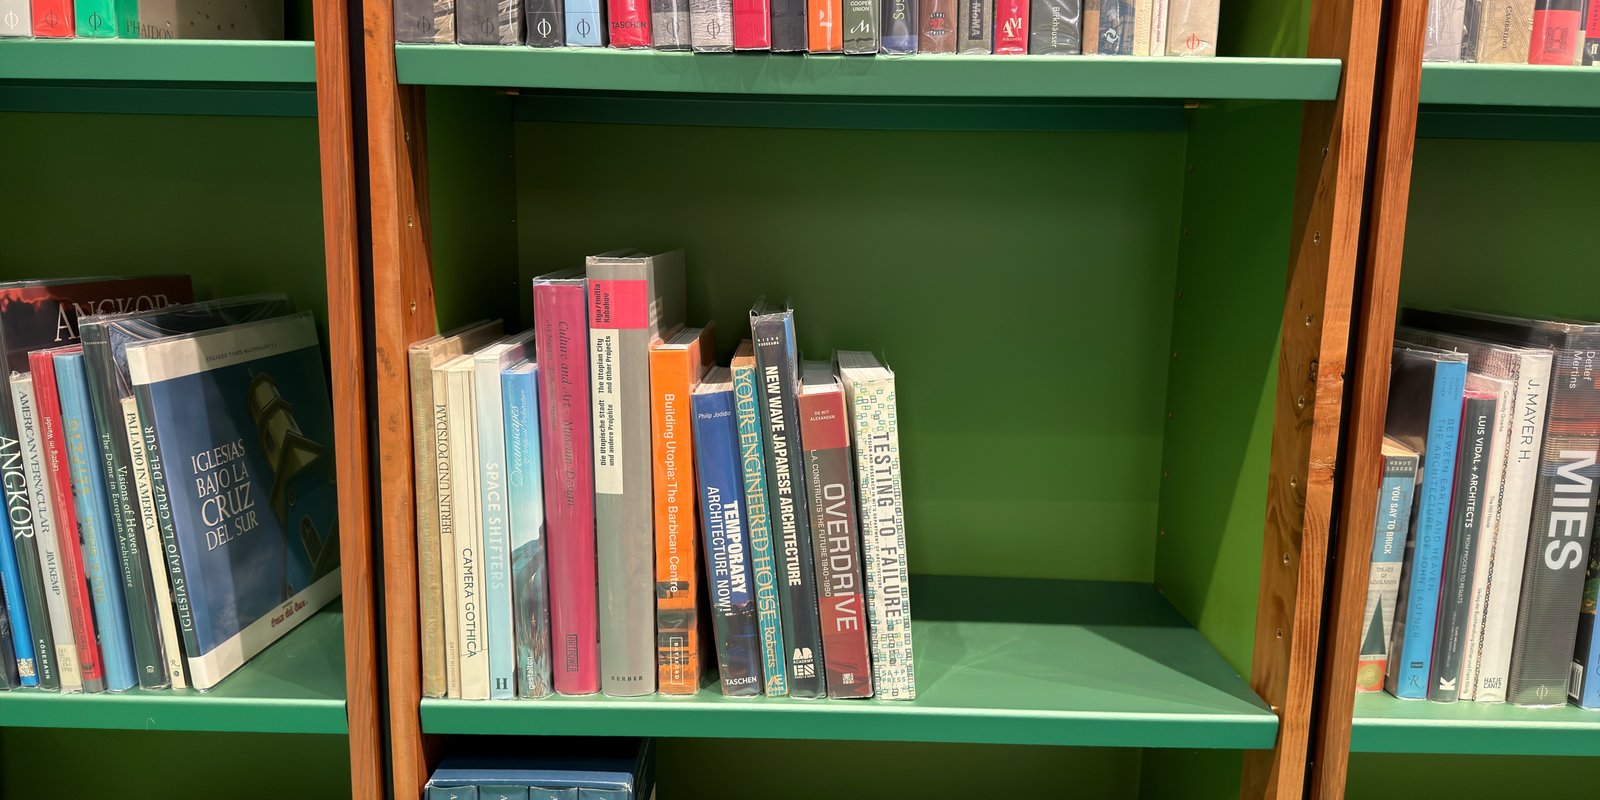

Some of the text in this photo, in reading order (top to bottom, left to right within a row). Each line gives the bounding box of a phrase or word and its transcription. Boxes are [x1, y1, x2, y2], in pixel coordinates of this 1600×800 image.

[126, 19, 174, 39] PHAIDON
[611, 21, 647, 29] TASCHEN
[1051, 6, 1061, 48] Birkhäuser
[1501, 5, 1513, 50] CAMBRIDGE
[559, 321, 571, 362] Culture
[596, 338, 604, 352] City
[560, 362, 573, 386] and
[597, 354, 605, 380] Utopian
[605, 361, 613, 381] Other
[1568, 350, 1584, 390] Mertins
[1583, 350, 1596, 381] Detlef
[598, 399, 606, 418] Stadt
[698, 410, 732, 420] Philip Jodidio
[734, 368, 756, 429] YOUR
[1519, 393, 1539, 445] MAYER
[44, 416, 54, 440] Wandel
[563, 418, 574, 466] Museum
[599, 420, 607, 454] Utopische
[1478, 415, 1487, 435] LUIS
[19, 391, 50, 533] AMERICAN VERNACULAR
[50, 449, 59, 472] Leipzig
[190, 438, 246, 475] IGLESIAS
[510, 405, 524, 488] Dreamscapes
[1473, 436, 1485, 465] VIDAL
[1517, 450, 1533, 464] H.
[0, 436, 35, 540] ANGKOR
[126, 412, 154, 531] PALLADIO IN AMERICA
[195, 461, 249, 498] BAJO LA
[435, 403, 452, 535] BERLIN UND POTSDAM
[564, 468, 576, 507] Design
[765, 366, 802, 587] NEW WAVE JAPANESE ARCHITECTURE
[811, 463, 823, 514] CONSTRUCTS
[102, 433, 132, 588] The Dome in European Architecture
[118, 465, 138, 555] Visions of Heaven
[201, 481, 255, 527] CRUZ
[664, 394, 680, 593] Building Utopia: The Barbican Centre
[741, 432, 770, 551] ENGINEERED
[1428, 418, 1455, 592] BETWEEN EARTH AND HEAVEN
[1464, 473, 1479, 528] ARCHITECTS
[1544, 450, 1597, 570] MIES
[144, 425, 193, 632] IGLESIAS BAJO LA CRUZ DEL SUR
[205, 510, 259, 551] DEL SUR
[486, 462, 504, 590] SPACE SHIFTERS
[817, 514, 825, 528] THE
[872, 431, 902, 618] TESTING TO FAILURE
[1383, 485, 1401, 555] YOU SAY TO BRICK
[1412, 419, 1446, 639] THE ARCHITECTURE OF JOHN LAUTNER
[707, 486, 732, 612] ARCHITECTURE NOW!
[723, 500, 747, 594] TEMPORARY
[818, 529, 828, 558] FUTURE
[823, 483, 858, 632] OVERDRIVE
[1461, 550, 1470, 575] PROCESS
[46, 550, 60, 596] JIM KEMP
[753, 556, 777, 621] HOUSE
[821, 558, 832, 598] 1940-1990
[1457, 583, 1465, 604] RESULTS
[462, 548, 477, 658] CAMERA GOTHICA
[39, 639, 51, 679] KÖNEMANN
[764, 626, 776, 669] Roberts
[725, 676, 757, 686] TASCHEN
[881, 676, 907, 684] PRESS
[1439, 676, 1456, 691] K
